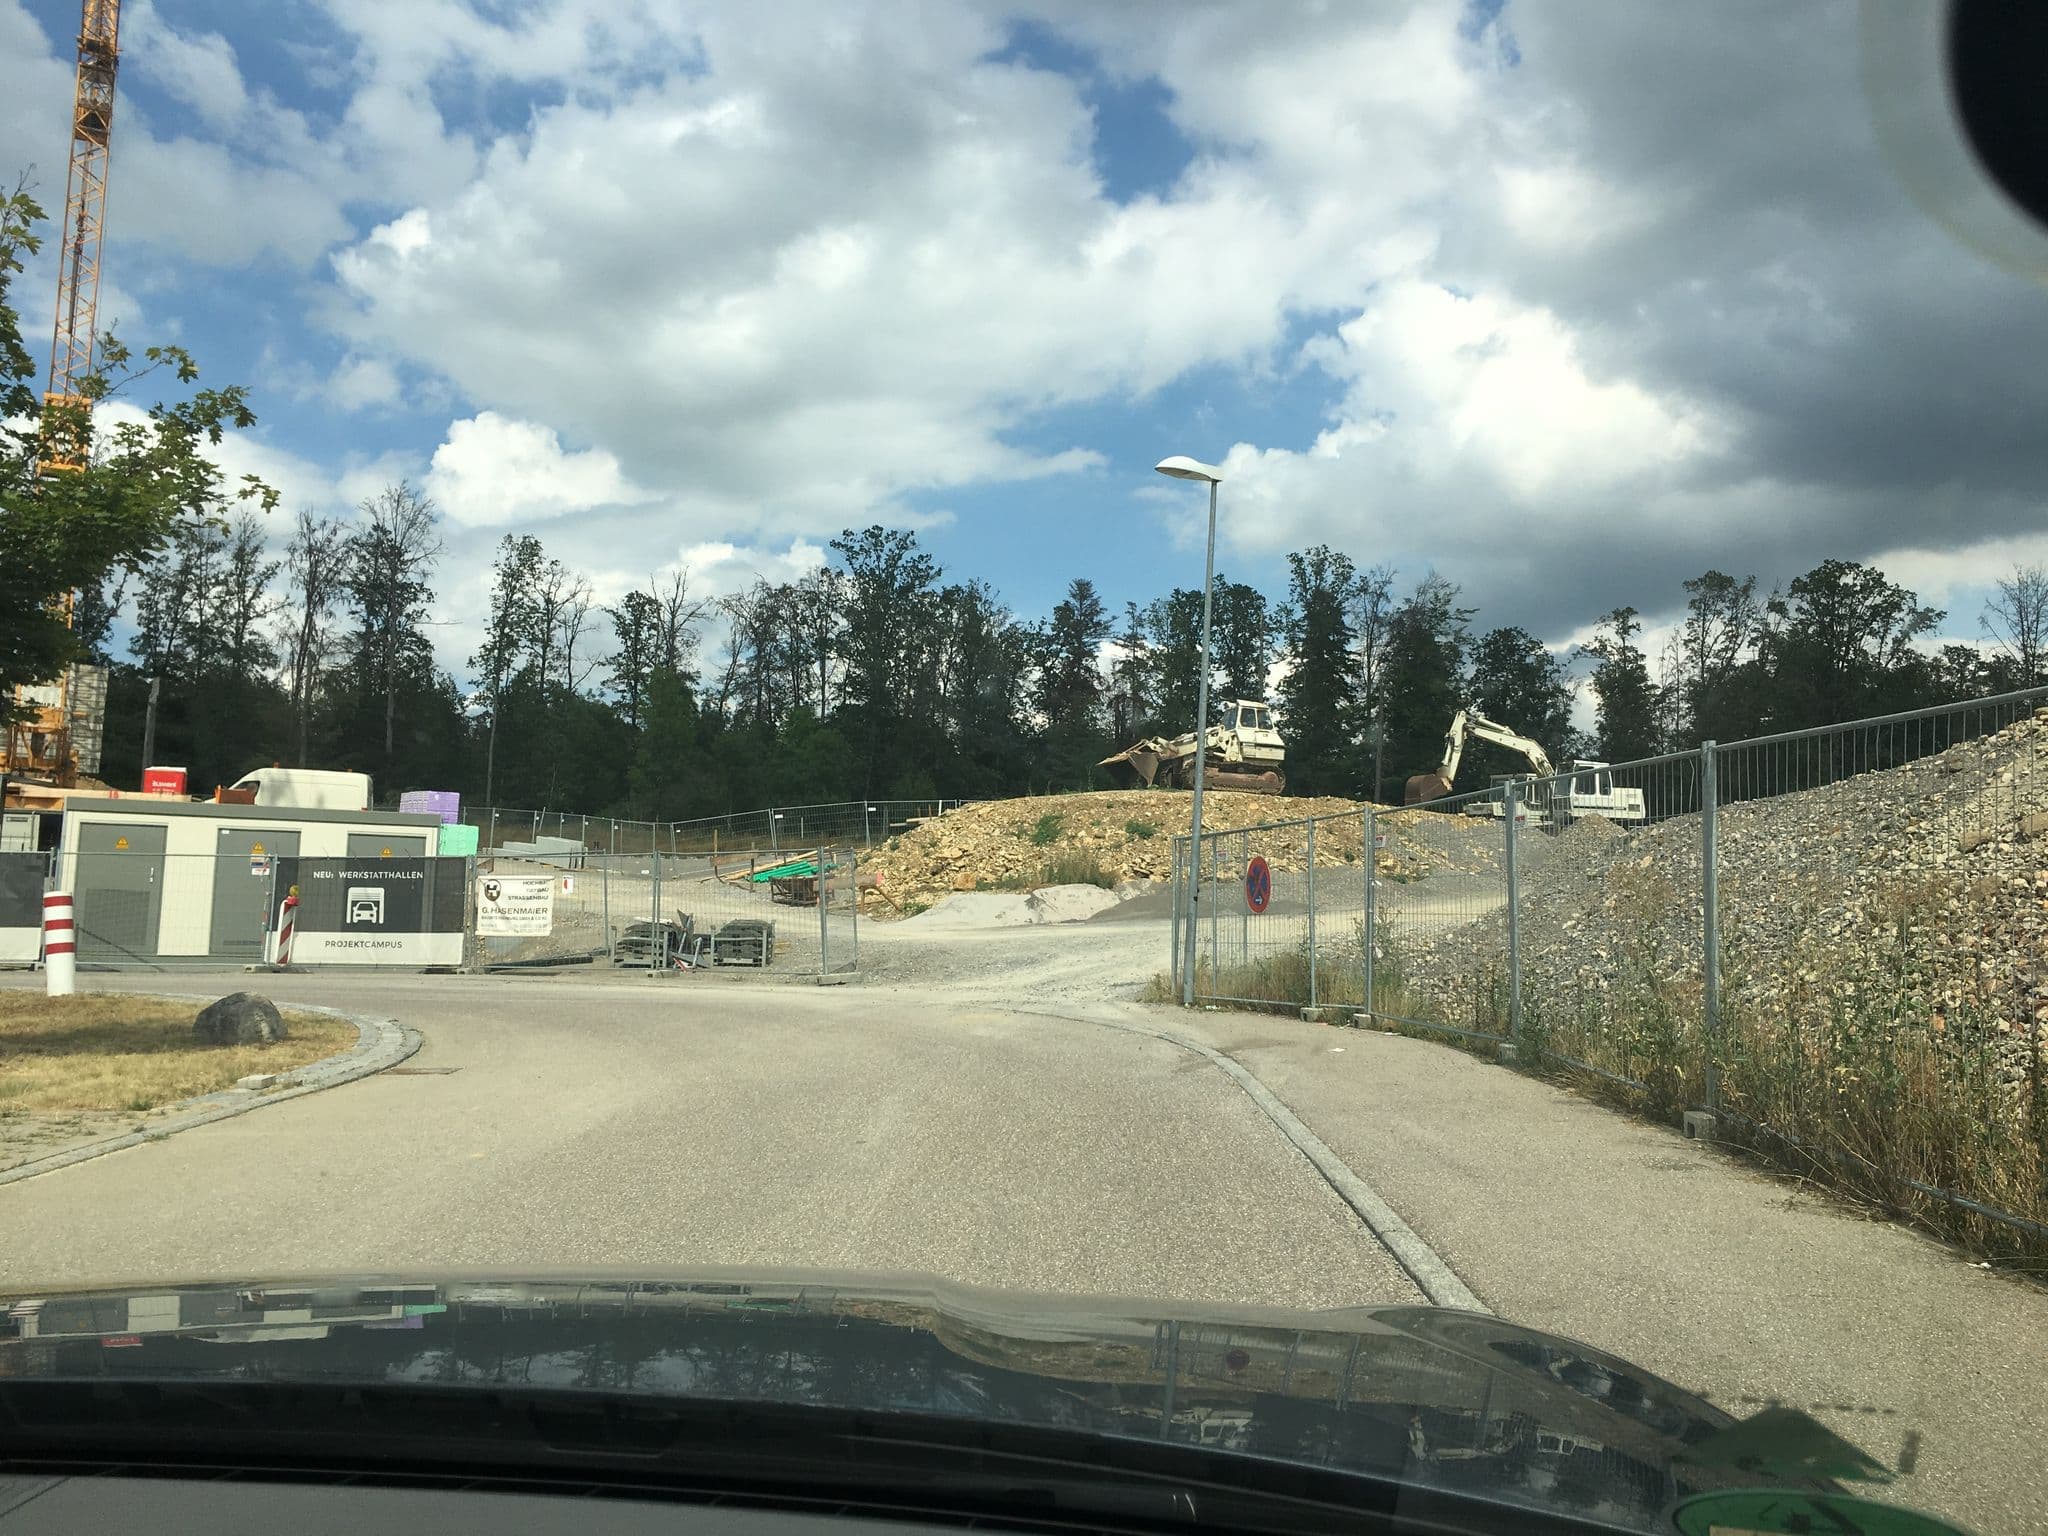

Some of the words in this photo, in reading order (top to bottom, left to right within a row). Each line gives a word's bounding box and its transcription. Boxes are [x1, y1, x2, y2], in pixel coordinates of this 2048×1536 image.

[313, 871, 334, 880] NEU:
[338, 871, 424, 880] WERKSTATTHALLEN
[325, 940, 403, 949] PROJEKTCAMPUS
